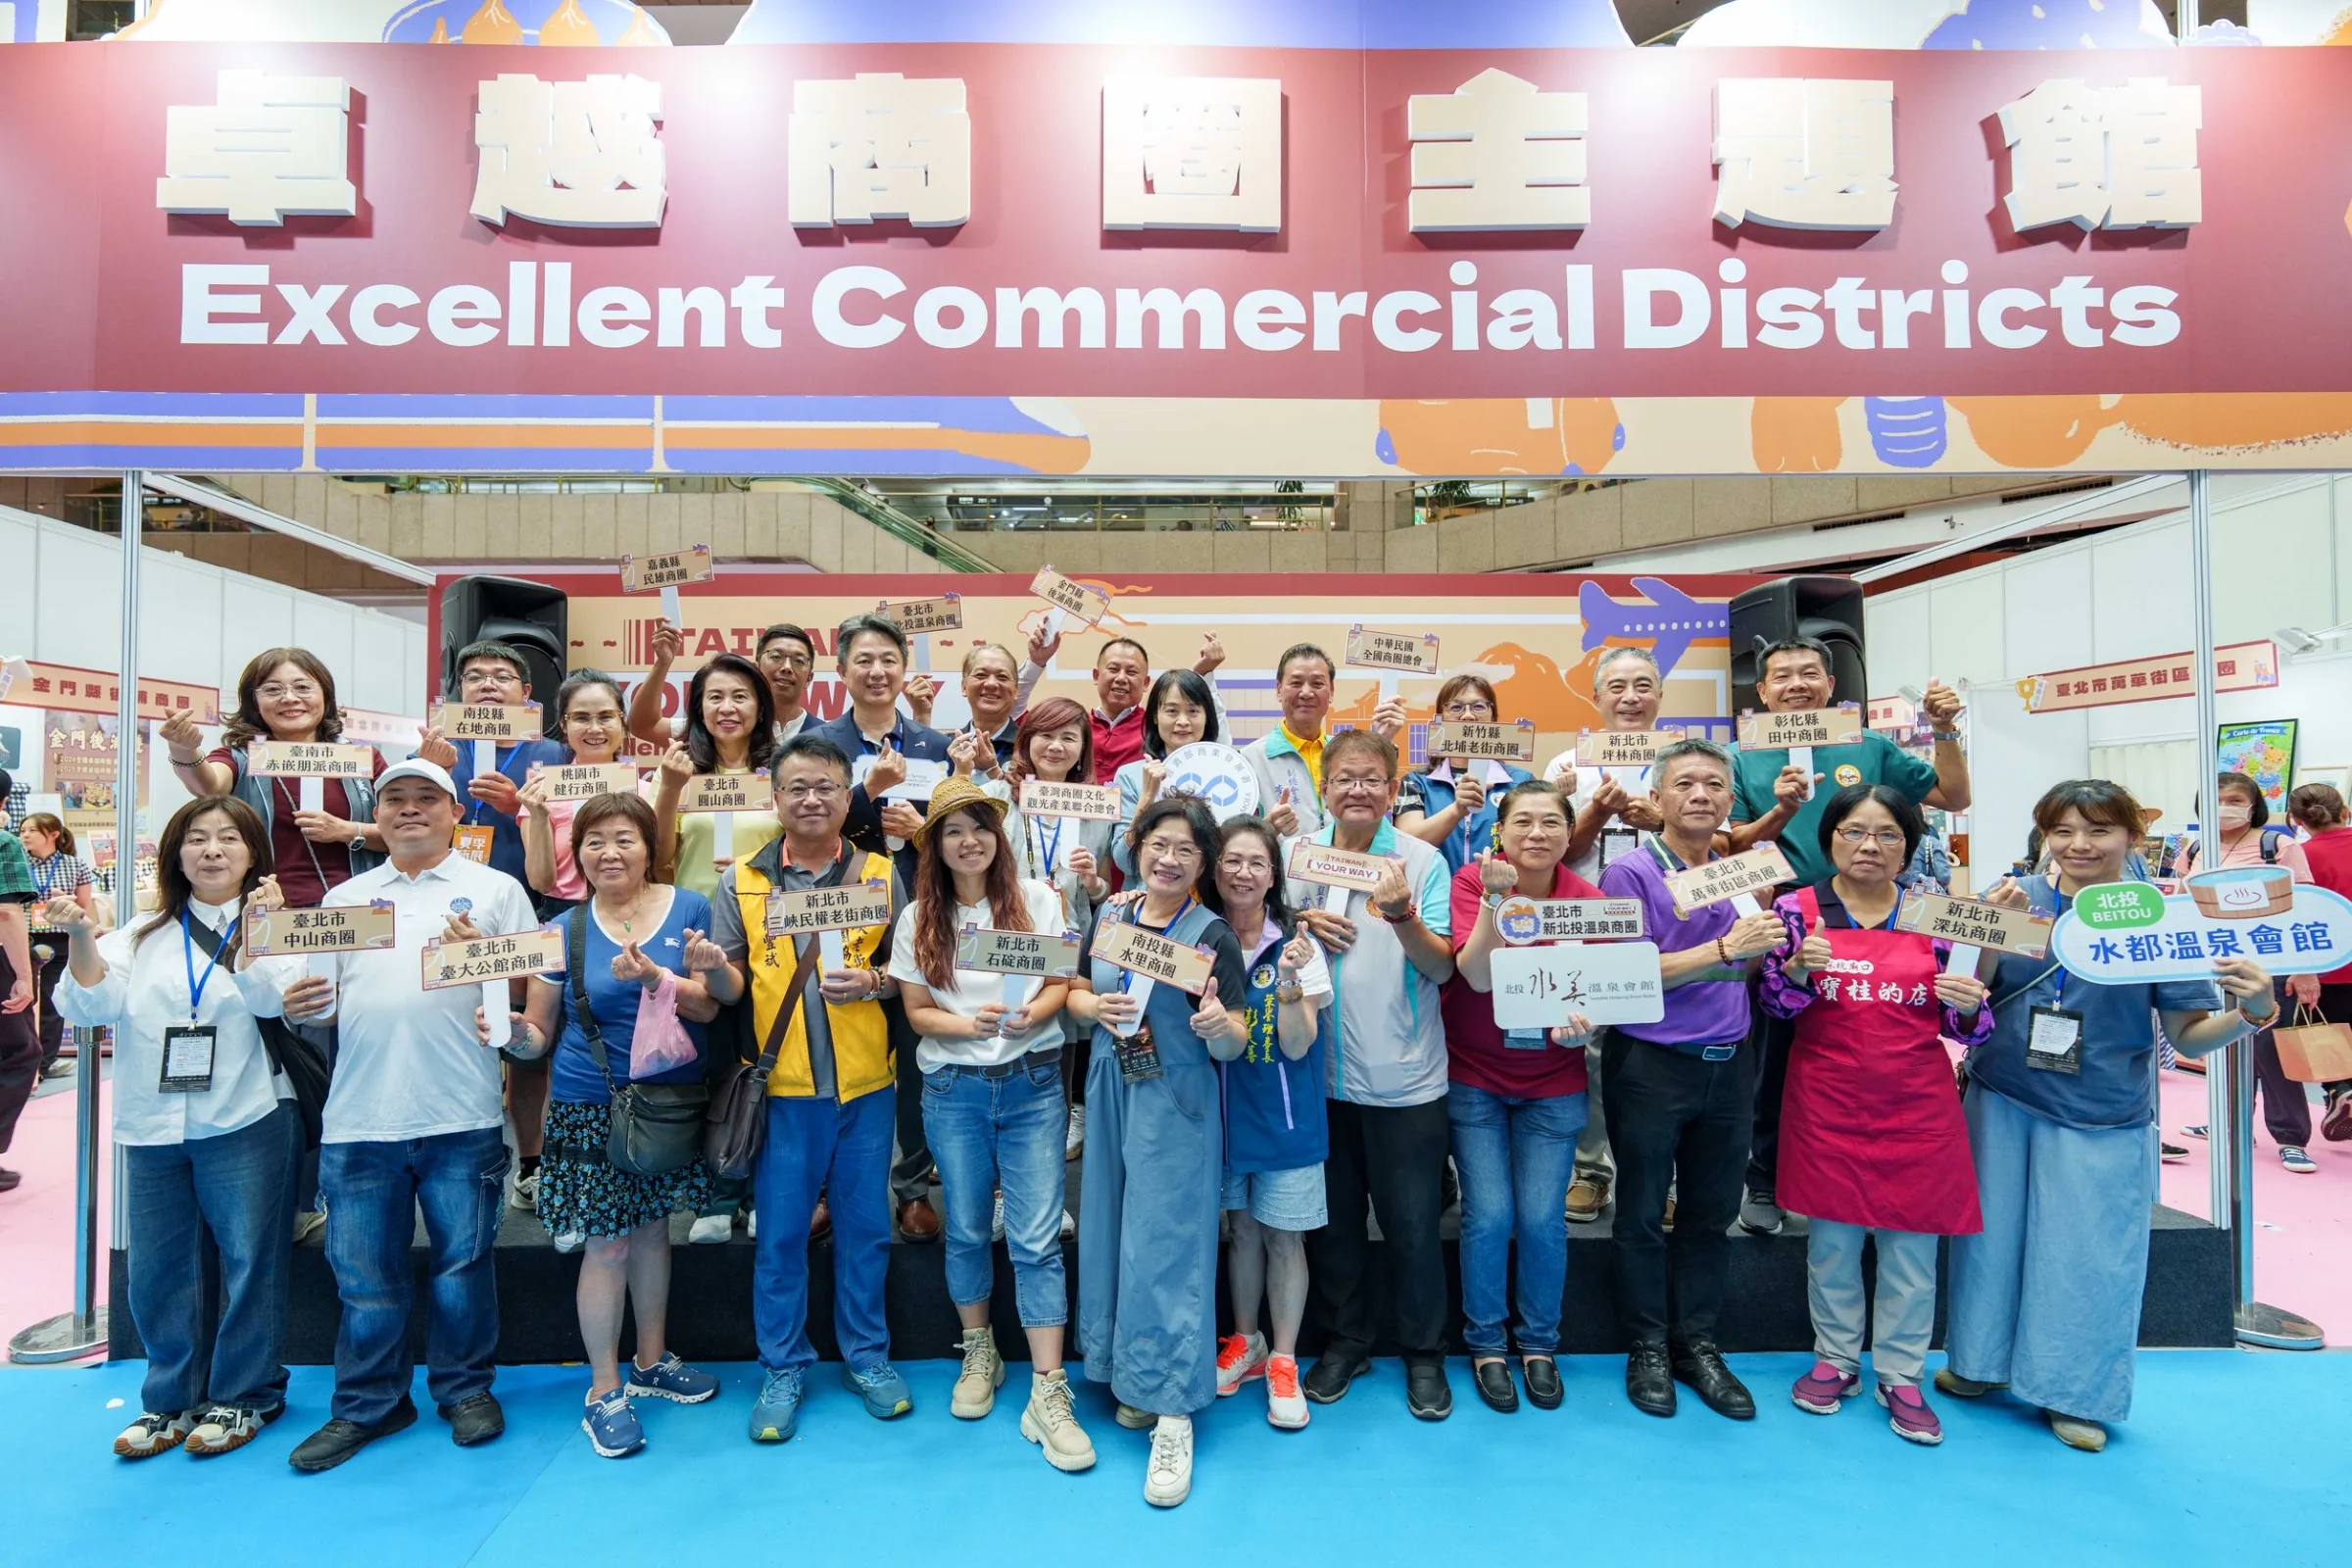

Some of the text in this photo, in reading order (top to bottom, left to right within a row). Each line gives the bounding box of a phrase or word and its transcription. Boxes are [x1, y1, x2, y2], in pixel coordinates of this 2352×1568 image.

[156, 67, 2202, 232] 卓越商圈主題館
[180, 258, 2180, 351] Excellent Commercial Districts
[647, 556, 680, 570] 嘉義縣
[643, 568, 688, 586] 民雄商圈
[1057, 579, 1085, 599] 金門縣
[1047, 587, 1083, 612] 後浦商圈
[903, 603, 933, 616] 臺北市
[895, 613, 956, 630] 北投溫泉商圈
[1374, 637, 1414, 652] 中華民國
[1362, 649, 1422, 666] 全國商圈總會
[2056, 660, 2235, 697] 臺北市萬華街區圈
[464, 707, 505, 720] 南投縣
[1774, 712, 1820, 727] 彰化縣
[456, 721, 511, 736] 在地商圈
[1462, 725, 1500, 739] 新竹縣
[1768, 728, 1828, 744] 田中商圈
[1441, 740, 1519, 756] 北埔老街商圈
[1608, 734, 1648, 747] 新北市
[289, 745, 334, 759] 臺南市
[1602, 749, 1656, 761] 坪林商圈
[266, 759, 357, 773] 赤嵌朋派商圈
[561, 766, 601, 780] 桃園市
[554, 781, 608, 796] 健行商圈
[704, 777, 739, 791] 臺北市
[698, 793, 746, 807] 圓山商圈
[1039, 785, 1105, 802] 臺灣商圈文化
[1027, 797, 1116, 815] 觀光產業聯合總會
[1316, 861, 1374, 878] YOUR WAY
[1330, 856, 1363, 866] TAIWAN
[1703, 858, 1746, 881] 臺北市
[1690, 865, 1778, 902] 萬華街區商圈
[805, 891, 849, 909] 新北市
[2097, 891, 2139, 907] 北投
[292, 911, 346, 928] 臺北市
[768, 905, 888, 929] 三峽民權老街商圈
[1543, 905, 1583, 919] 臺北市
[1945, 901, 2002, 925] 新北市
[2092, 907, 2152, 923] BEITOU
[1543, 920, 1638, 936] 新北投溫泉商圈
[1932, 916, 2006, 946] 深坑商圈
[283, 930, 356, 948] 中山商圈
[996, 935, 1041, 954] 新北市
[1132, 932, 1175, 958] 南投縣
[2088, 921, 2333, 964] 水都溫泉會館
[466, 939, 516, 959] 臺北市
[440, 952, 544, 981] 臺大公館商圈
[986, 953, 1046, 971] 石碇商圈
[1118, 948, 1177, 979] 水里商圈
[1588, 980, 1654, 994] 溫泉會館
[1820, 975, 1928, 1005] 寶桂的店
